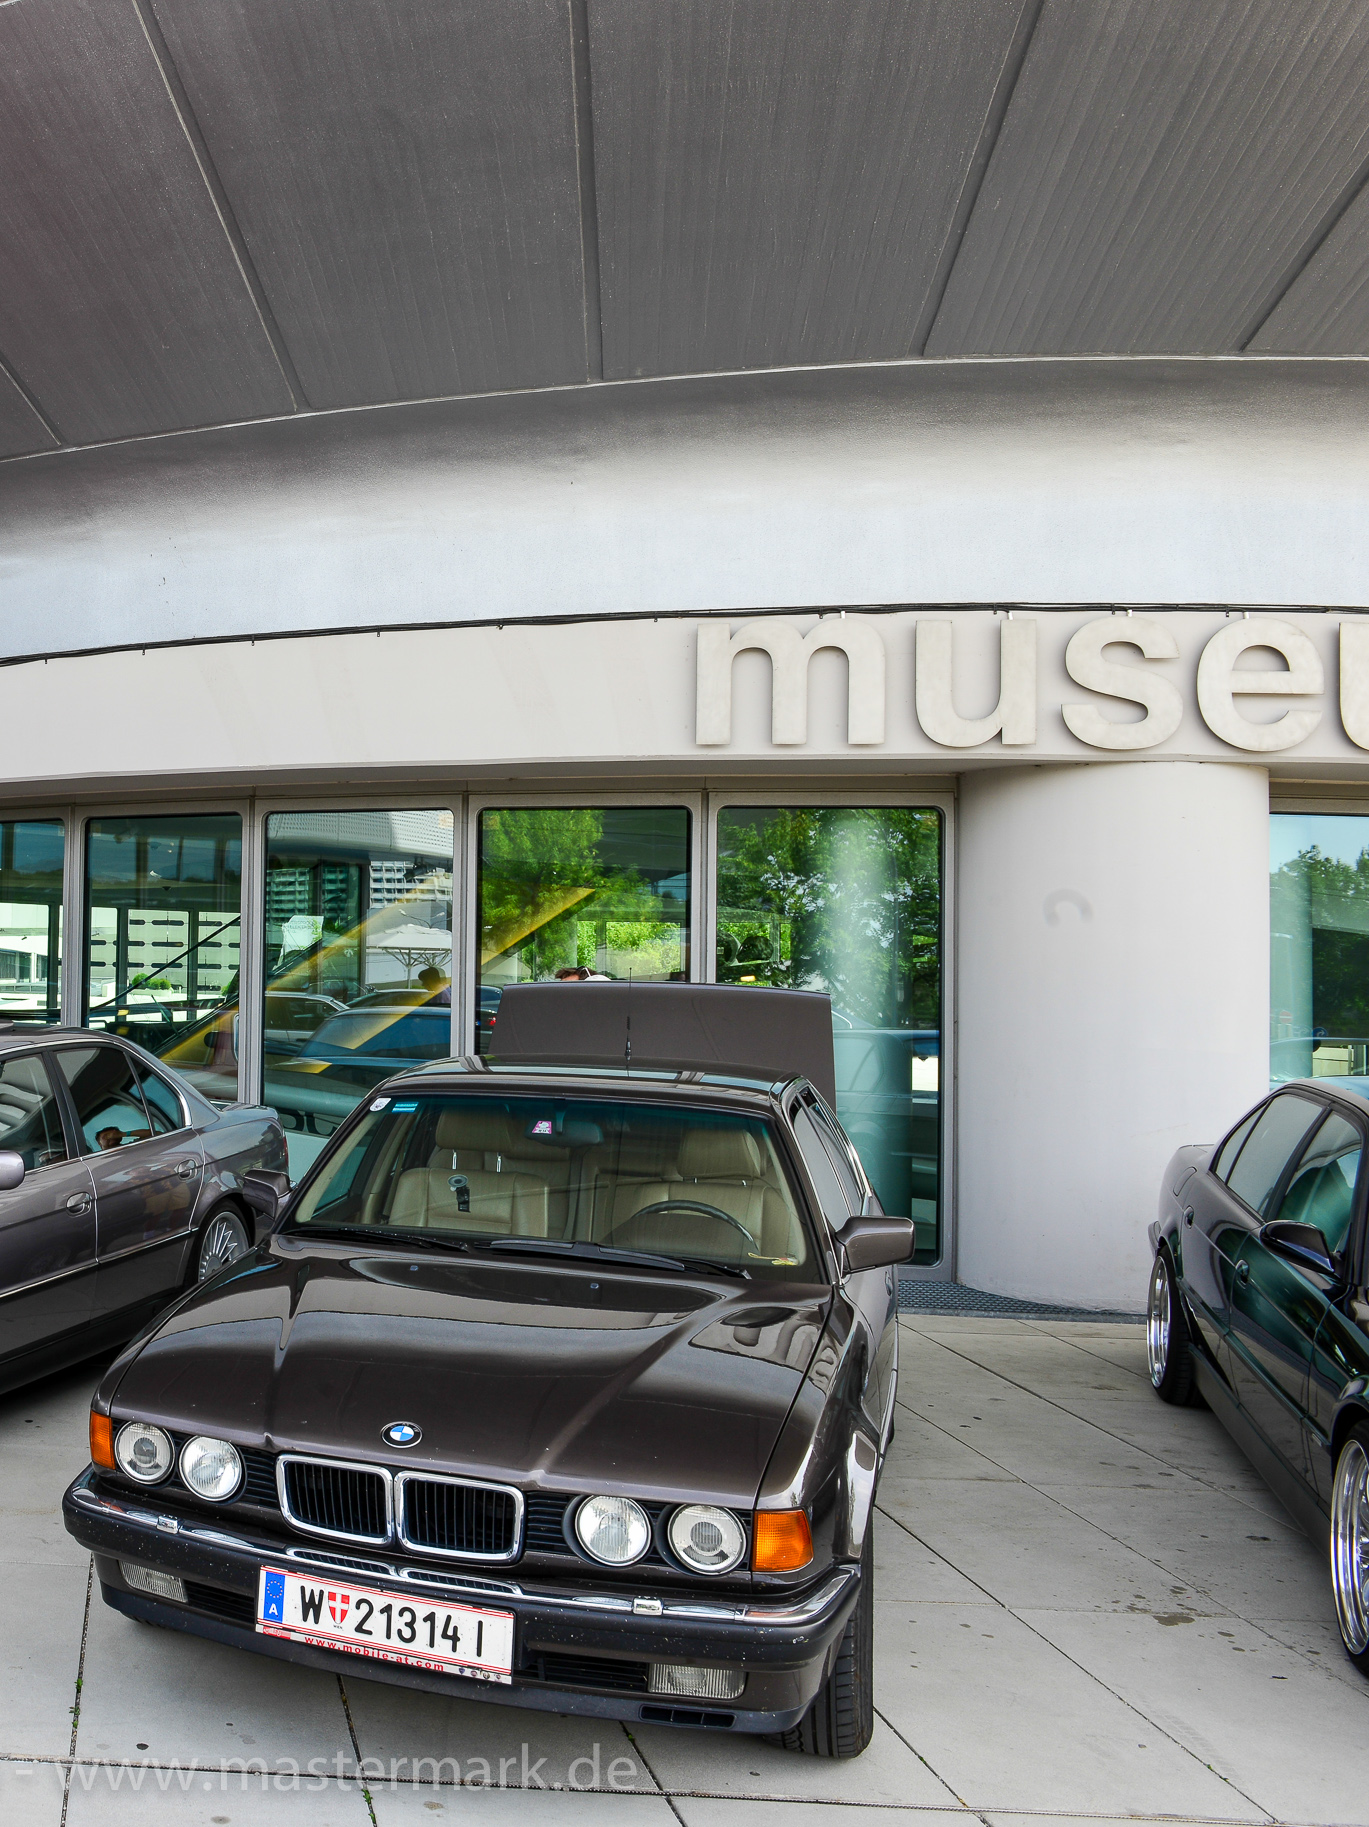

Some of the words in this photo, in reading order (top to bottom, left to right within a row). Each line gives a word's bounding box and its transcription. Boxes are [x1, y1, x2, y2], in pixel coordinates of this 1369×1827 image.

[696, 615, 1369, 752] muse
[268, 1603, 279, 1615] A
[300, 1585, 324, 1625] W
[354, 1598, 461, 1653] 21314
[304, 1636, 445, 1672] www.mobile-at.com
